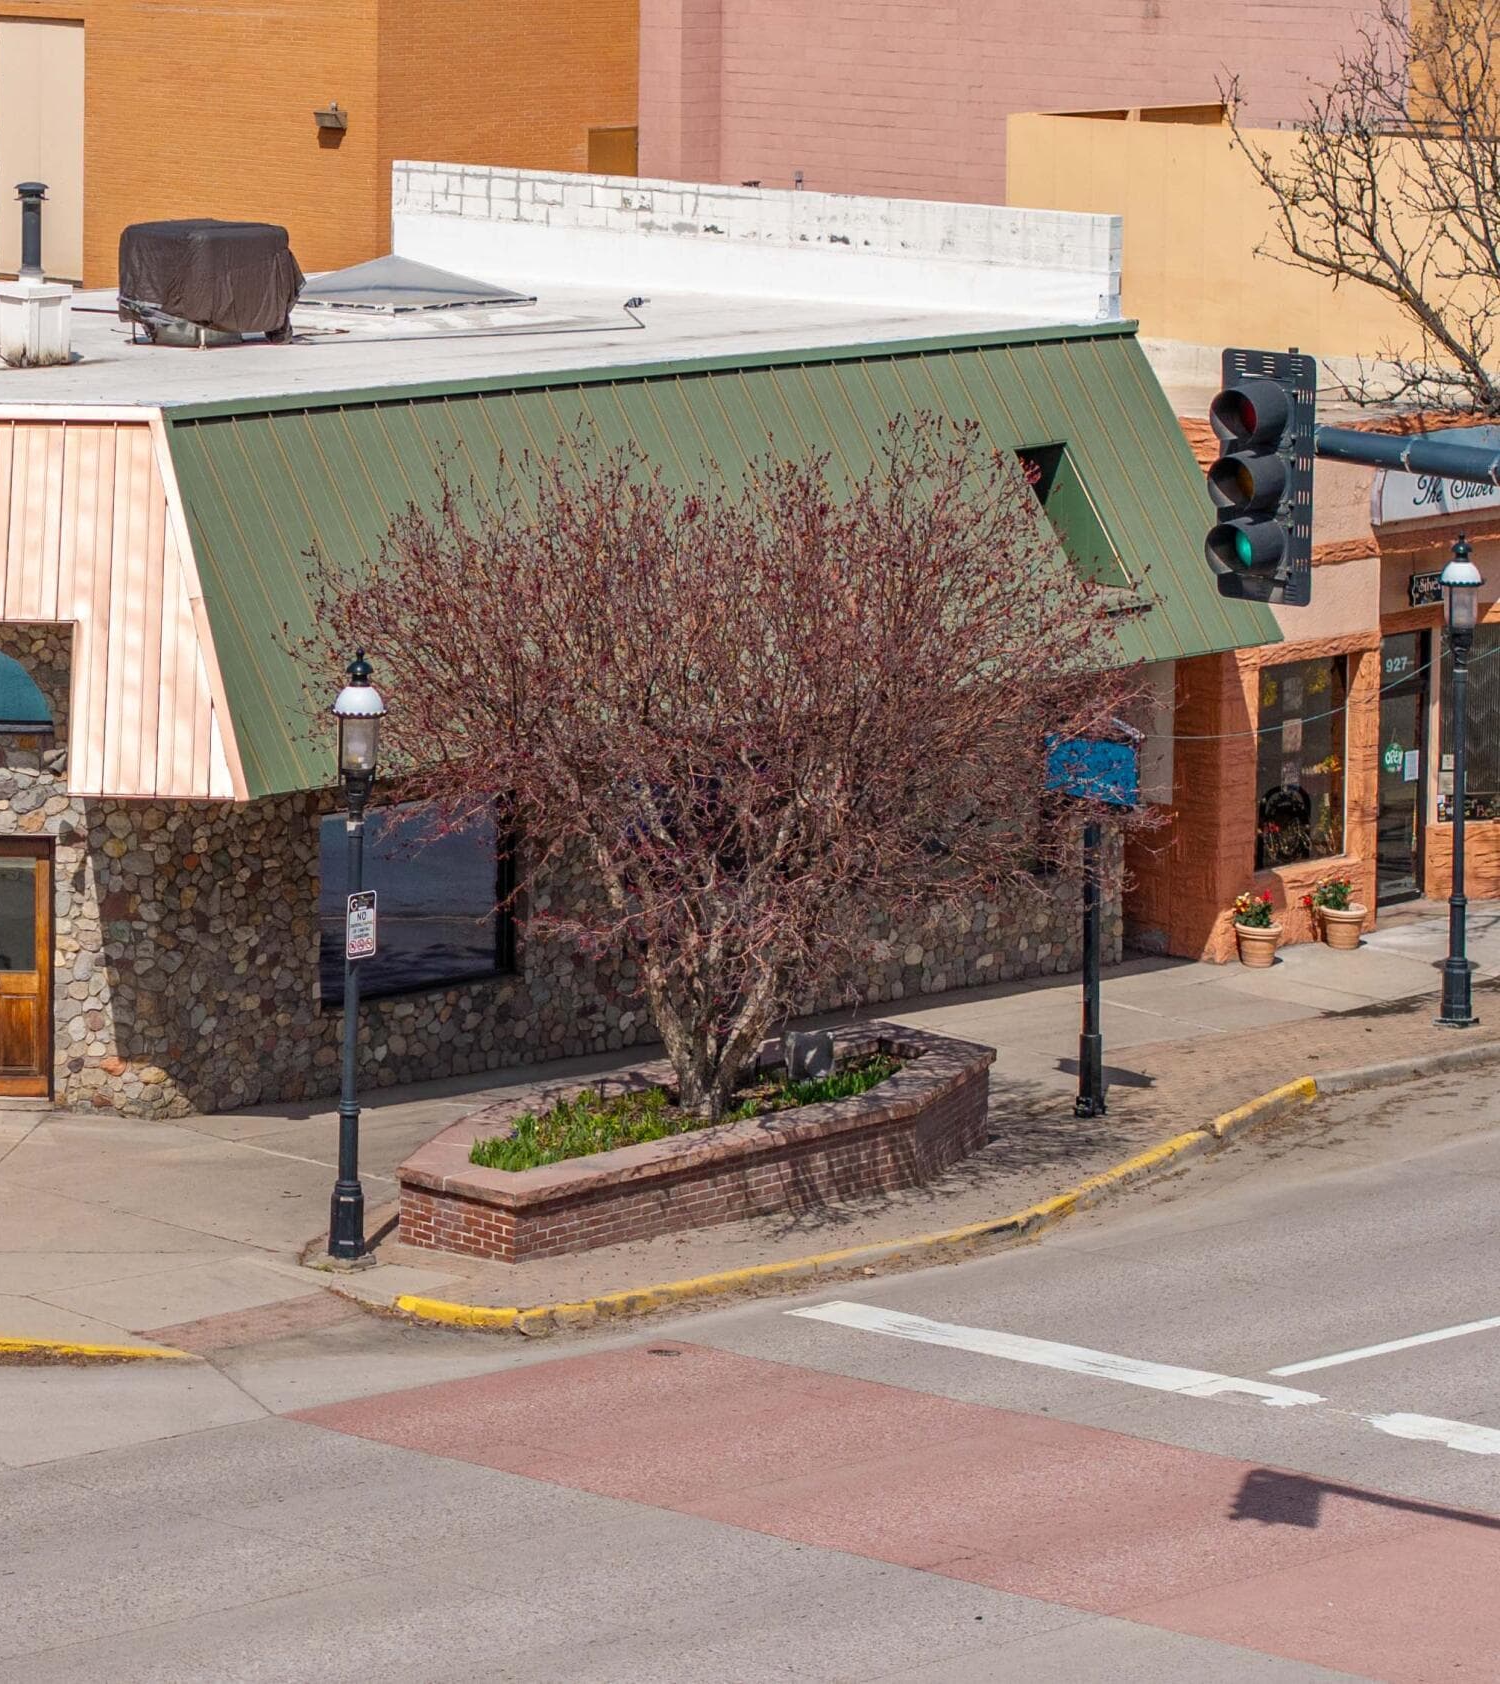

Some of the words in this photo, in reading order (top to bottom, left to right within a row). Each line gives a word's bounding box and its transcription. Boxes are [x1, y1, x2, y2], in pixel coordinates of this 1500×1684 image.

[1413, 475, 1442, 505] The
[1385, 656, 1408, 673] 927
[1385, 749, 1404, 765] OPEN
[357, 912, 367, 921] NO
